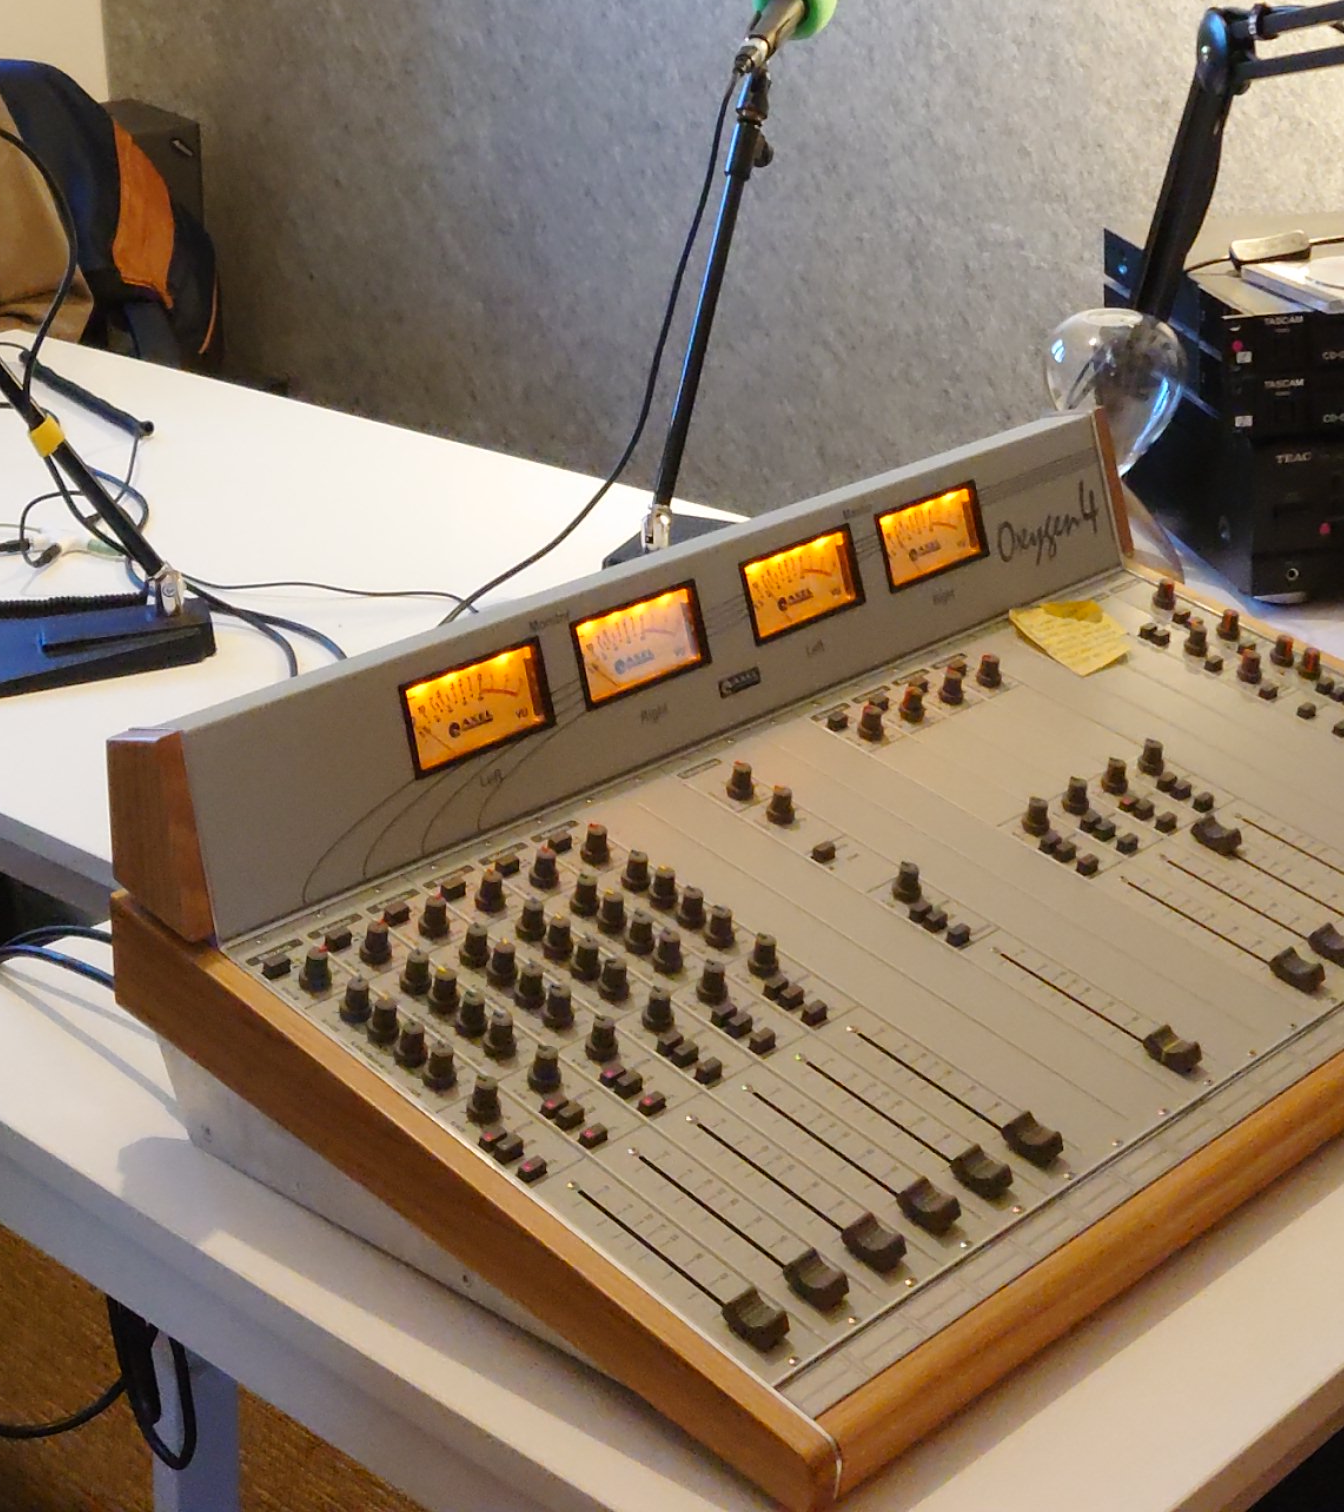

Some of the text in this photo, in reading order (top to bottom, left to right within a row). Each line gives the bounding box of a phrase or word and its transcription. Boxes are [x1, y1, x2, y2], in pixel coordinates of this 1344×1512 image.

[1264, 315, 1304, 326] TASCAM
[1264, 378, 1305, 388] TASCAM
[1275, 452, 1312, 464] TEAC
[462, 707, 529, 731] AXEL VU
[641, 703, 668, 724] Right
